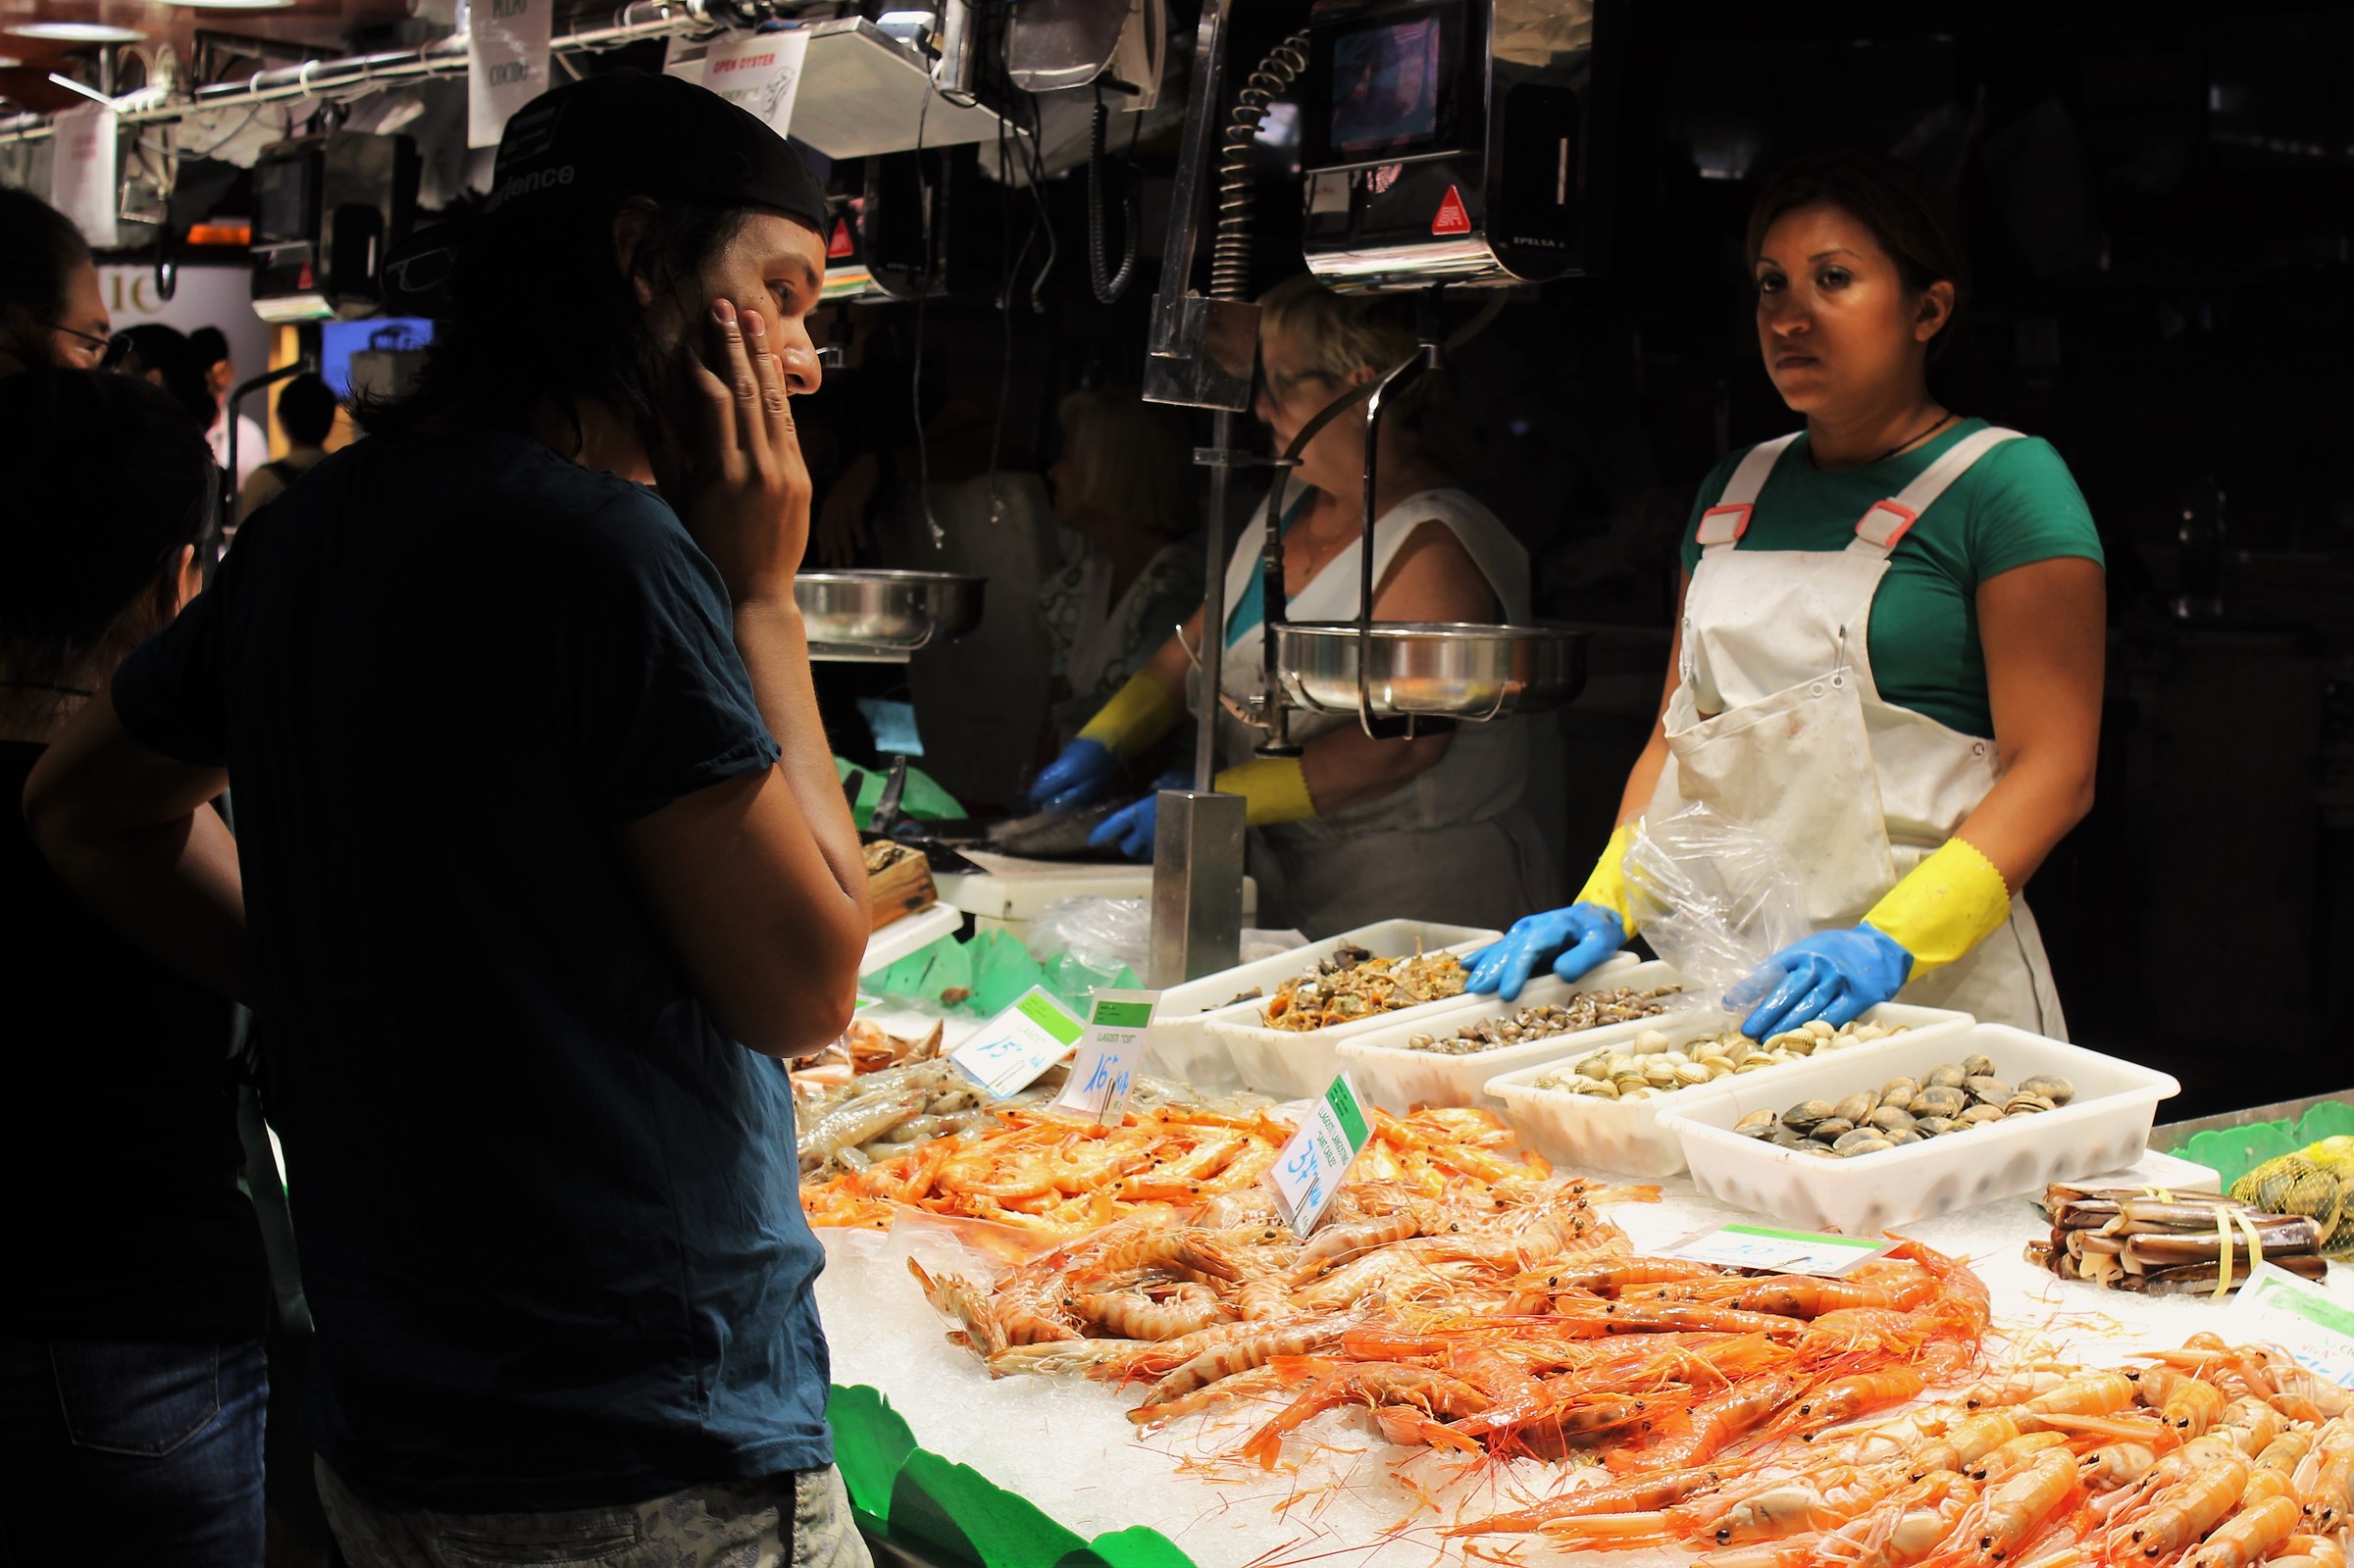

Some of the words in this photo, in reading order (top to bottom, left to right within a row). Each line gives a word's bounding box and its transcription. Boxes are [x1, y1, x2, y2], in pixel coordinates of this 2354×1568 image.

[714, 60, 737, 74] OPEN
[739, 53, 775, 70] OYSTER
[1513, 236, 1556, 247] EPELSA
